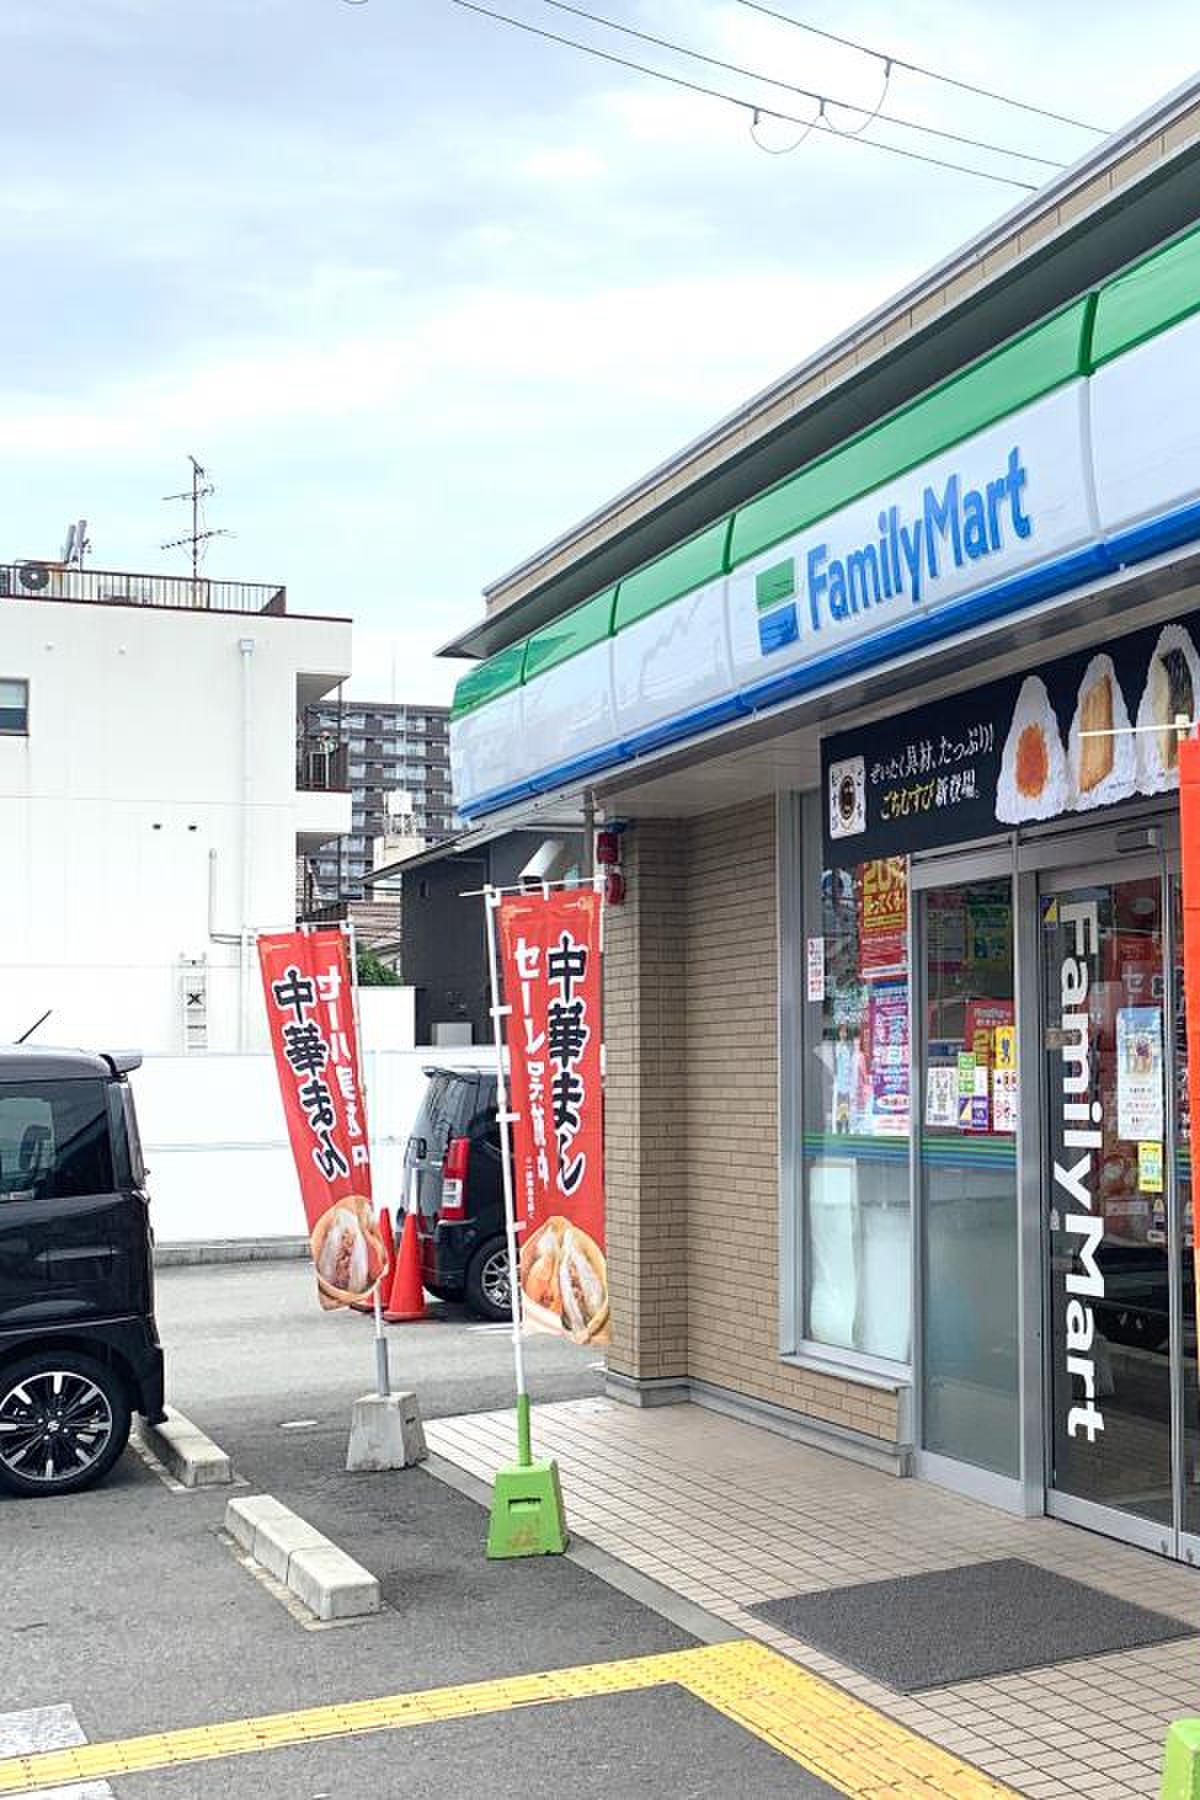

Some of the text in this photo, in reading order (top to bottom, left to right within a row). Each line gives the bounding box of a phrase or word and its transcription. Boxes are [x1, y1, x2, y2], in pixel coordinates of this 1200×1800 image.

[807, 446, 1031, 630] FamilyMart
[546, 930, 588, 1196] 中華まん
[1054, 901, 1105, 1442] FamilyMart
